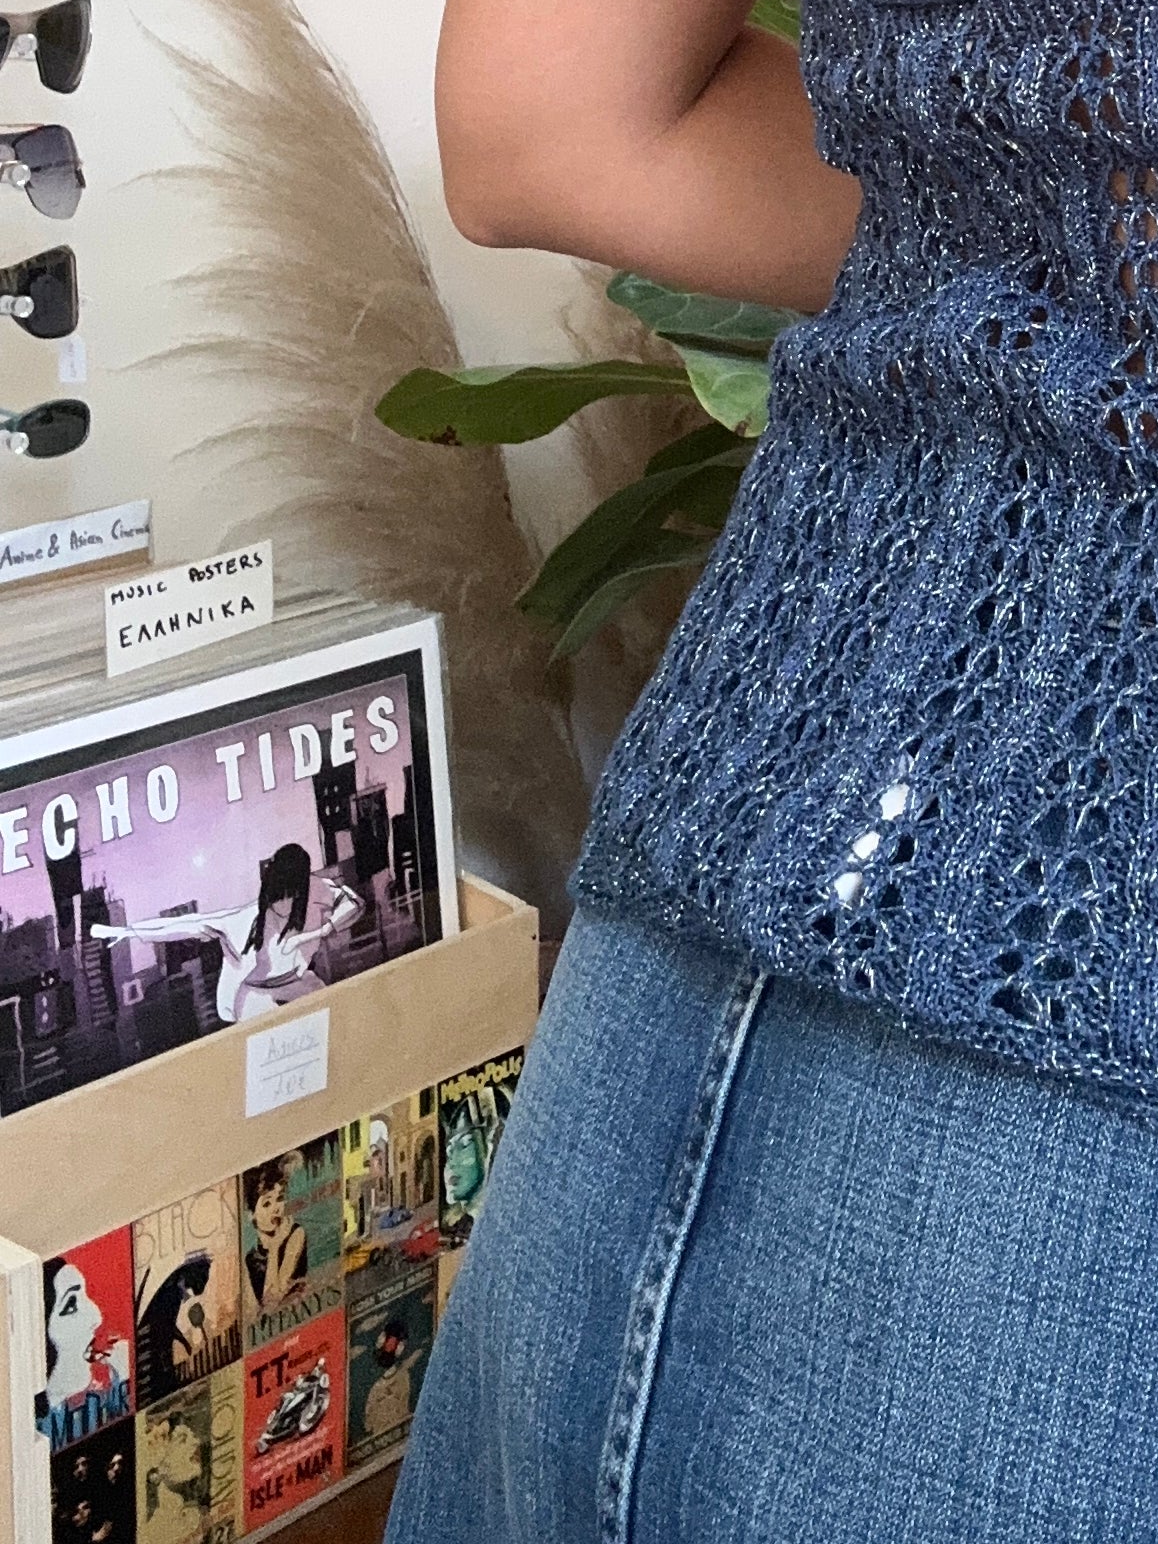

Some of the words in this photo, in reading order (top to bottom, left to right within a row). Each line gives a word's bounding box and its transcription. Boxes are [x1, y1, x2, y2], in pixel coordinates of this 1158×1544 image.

[47, 533, 60, 558] &
[70, 530, 104, 550] Asian
[110, 582, 168, 605] MUSIC
[188, 552, 263, 583] POSTERS
[0, 764, 180, 874] ECHO
[215, 695, 400, 803] TIDES
